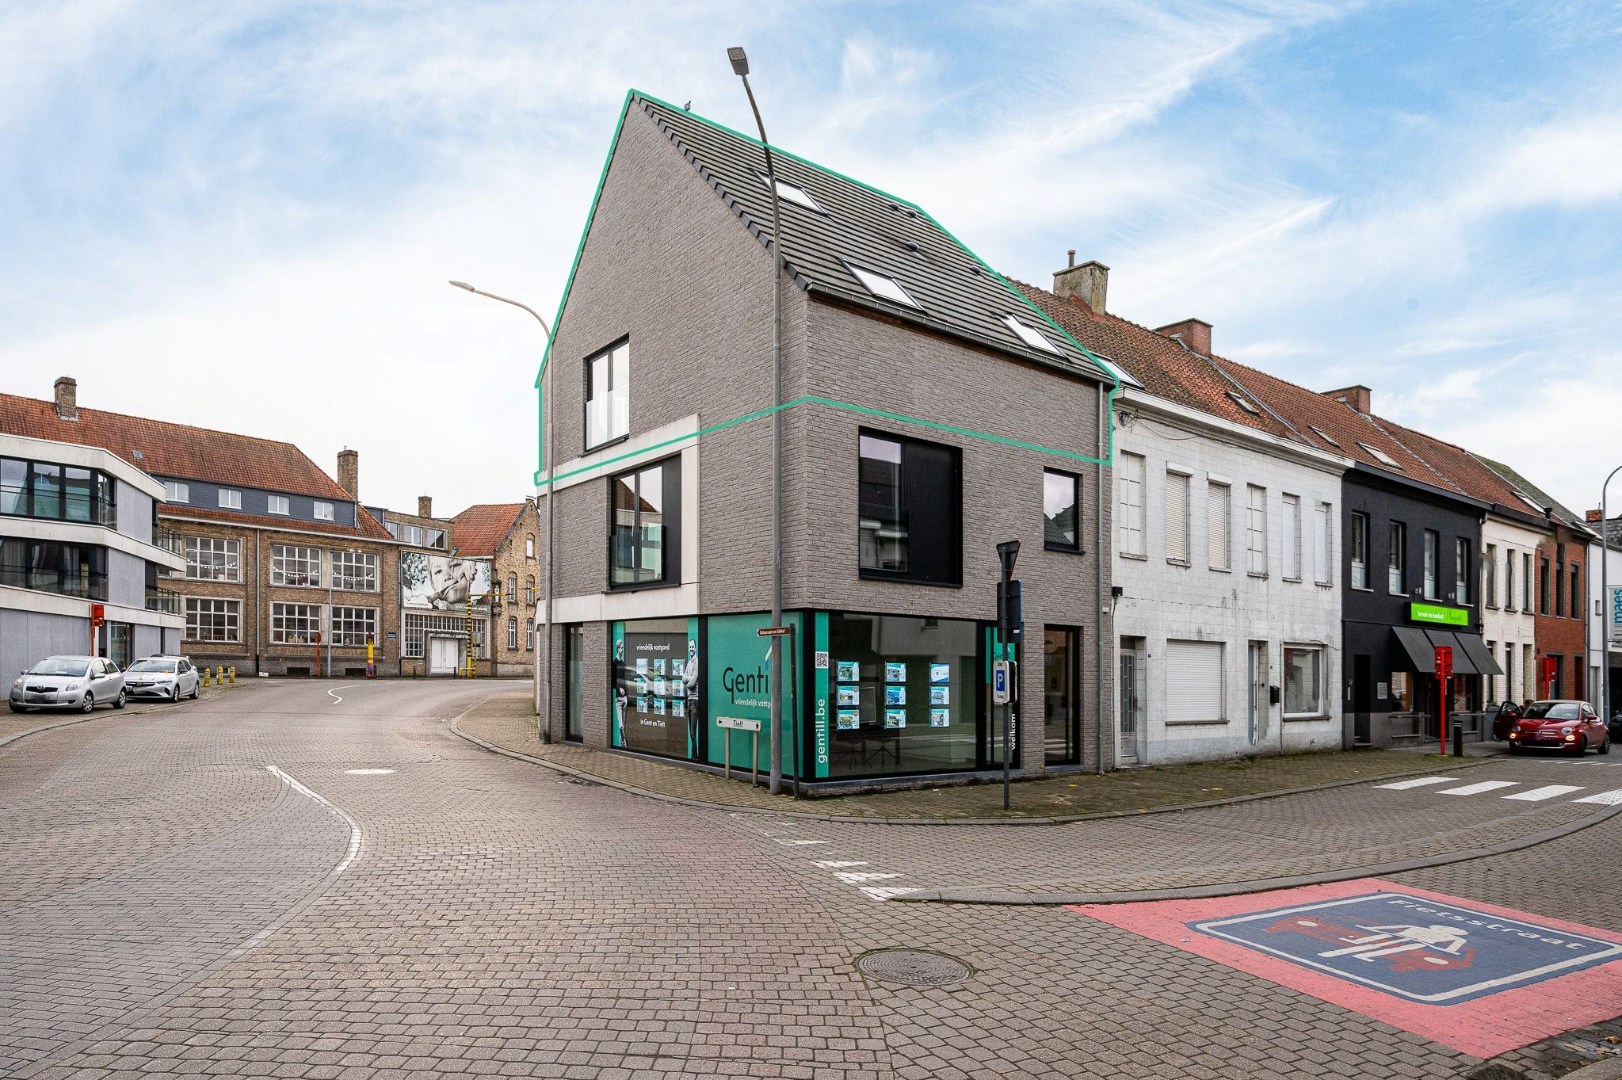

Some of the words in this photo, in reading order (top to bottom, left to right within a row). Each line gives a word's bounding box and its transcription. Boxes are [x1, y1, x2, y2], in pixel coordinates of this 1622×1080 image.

[636, 643, 653, 652] vriendelijk
[654, 644, 670, 652] vastgoed
[722, 666, 769, 704] Genti
[735, 698, 757, 708] vriendelijk
[758, 700, 772, 709] vastg
[644, 718, 652, 726] Gent
[815, 699, 828, 764] gentill.be
[1387, 899, 1586, 950] Fietsstraat
